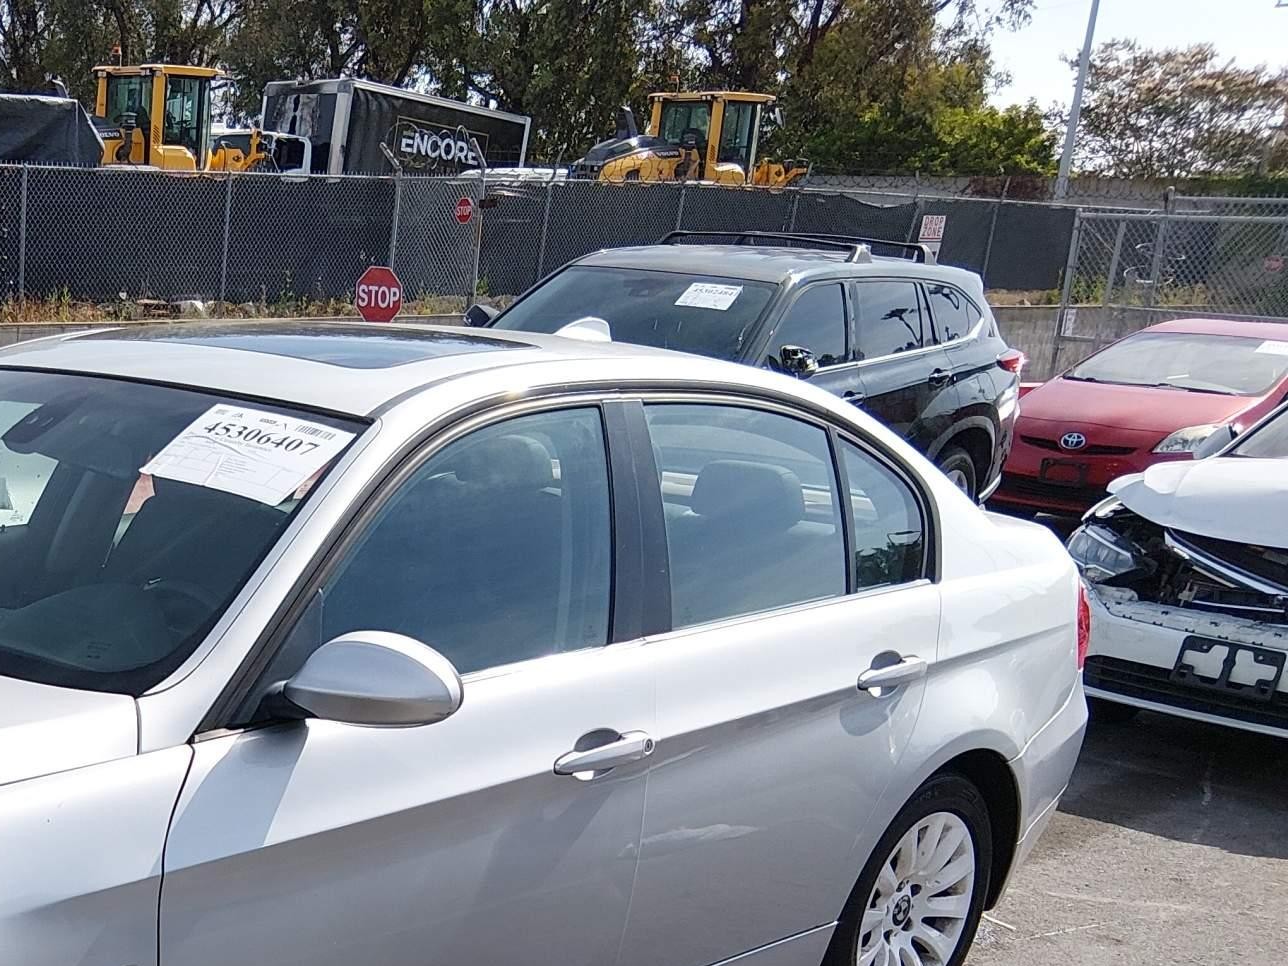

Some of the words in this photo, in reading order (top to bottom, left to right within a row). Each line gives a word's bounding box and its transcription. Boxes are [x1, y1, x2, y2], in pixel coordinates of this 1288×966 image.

[400, 130, 479, 166] ENCORE
[456, 205, 472, 217] STOP
[924, 216, 944, 226] DROP
[921, 226, 943, 237] ZONE
[358, 284, 400, 308] STOP
[203, 421, 321, 456] 45306407
